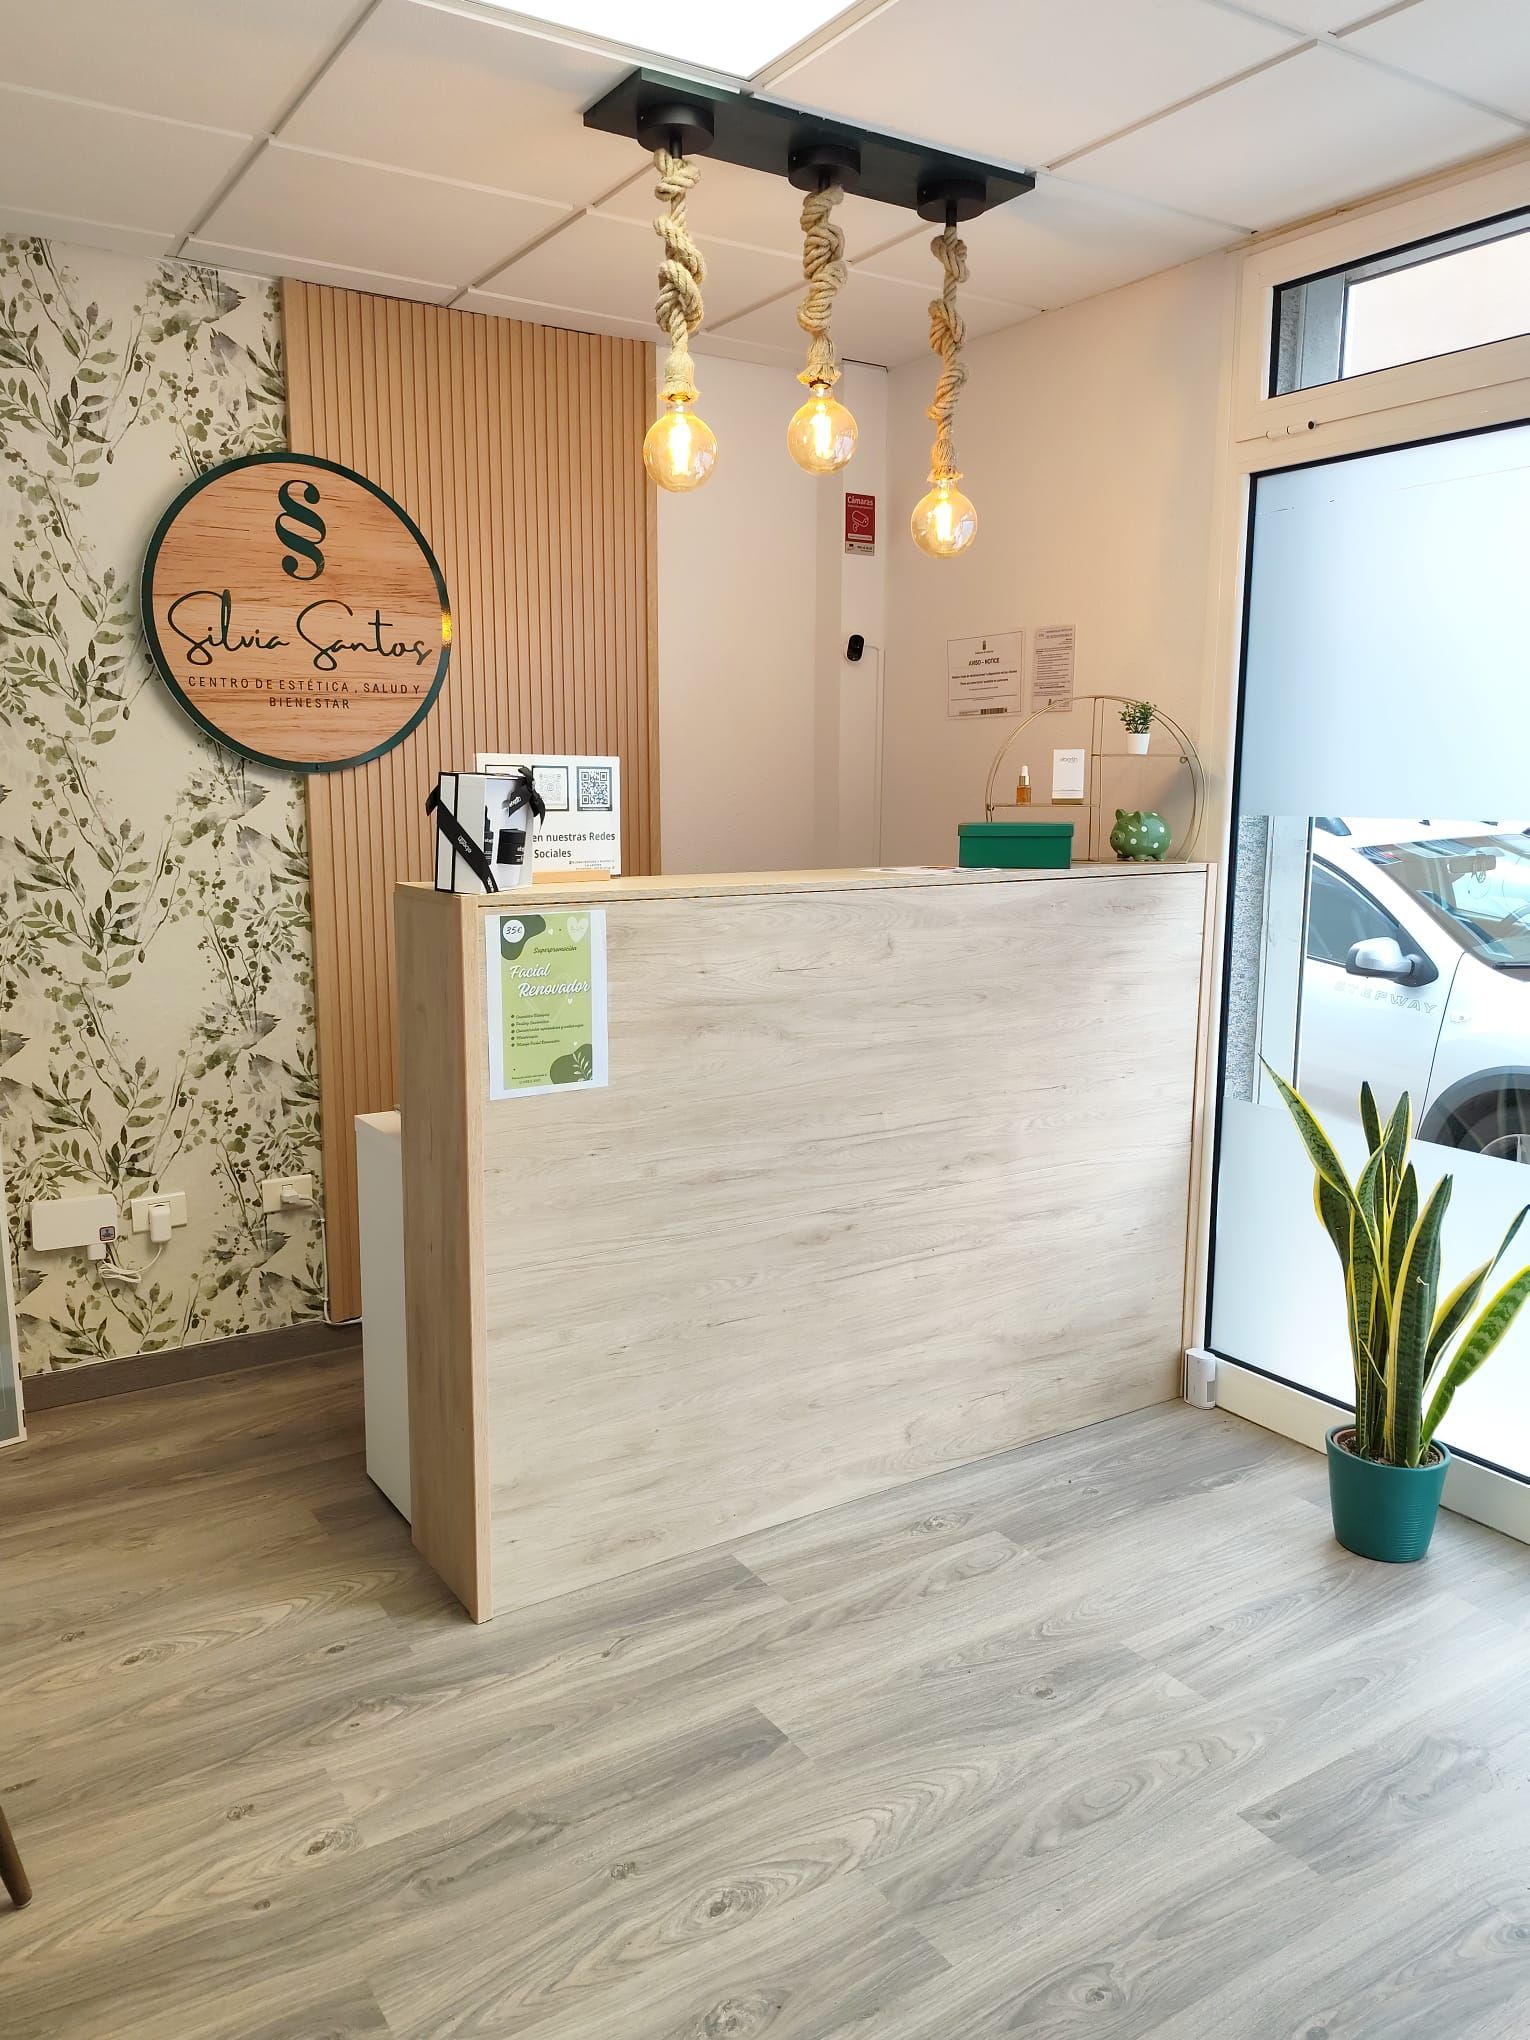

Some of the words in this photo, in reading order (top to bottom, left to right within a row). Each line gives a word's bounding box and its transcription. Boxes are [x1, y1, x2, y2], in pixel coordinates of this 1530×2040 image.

[167, 589, 290, 666] Silvia
[296, 599, 433, 671] Santos
[188, 676, 249, 689] CENTRO
[255, 678, 273, 690] DE
[363, 682, 408, 694] SALUD
[413, 684, 420, 695] Y
[269, 696, 350, 710] BIENESTAR
[546, 832, 587, 842] nuestras
[589, 831, 616, 841] Redes
[534, 848, 572, 859] Sociales
[510, 963, 551, 979] Facial
[518, 979, 591, 997] Renovador
[1334, 981, 1437, 1013] STEPWAY
